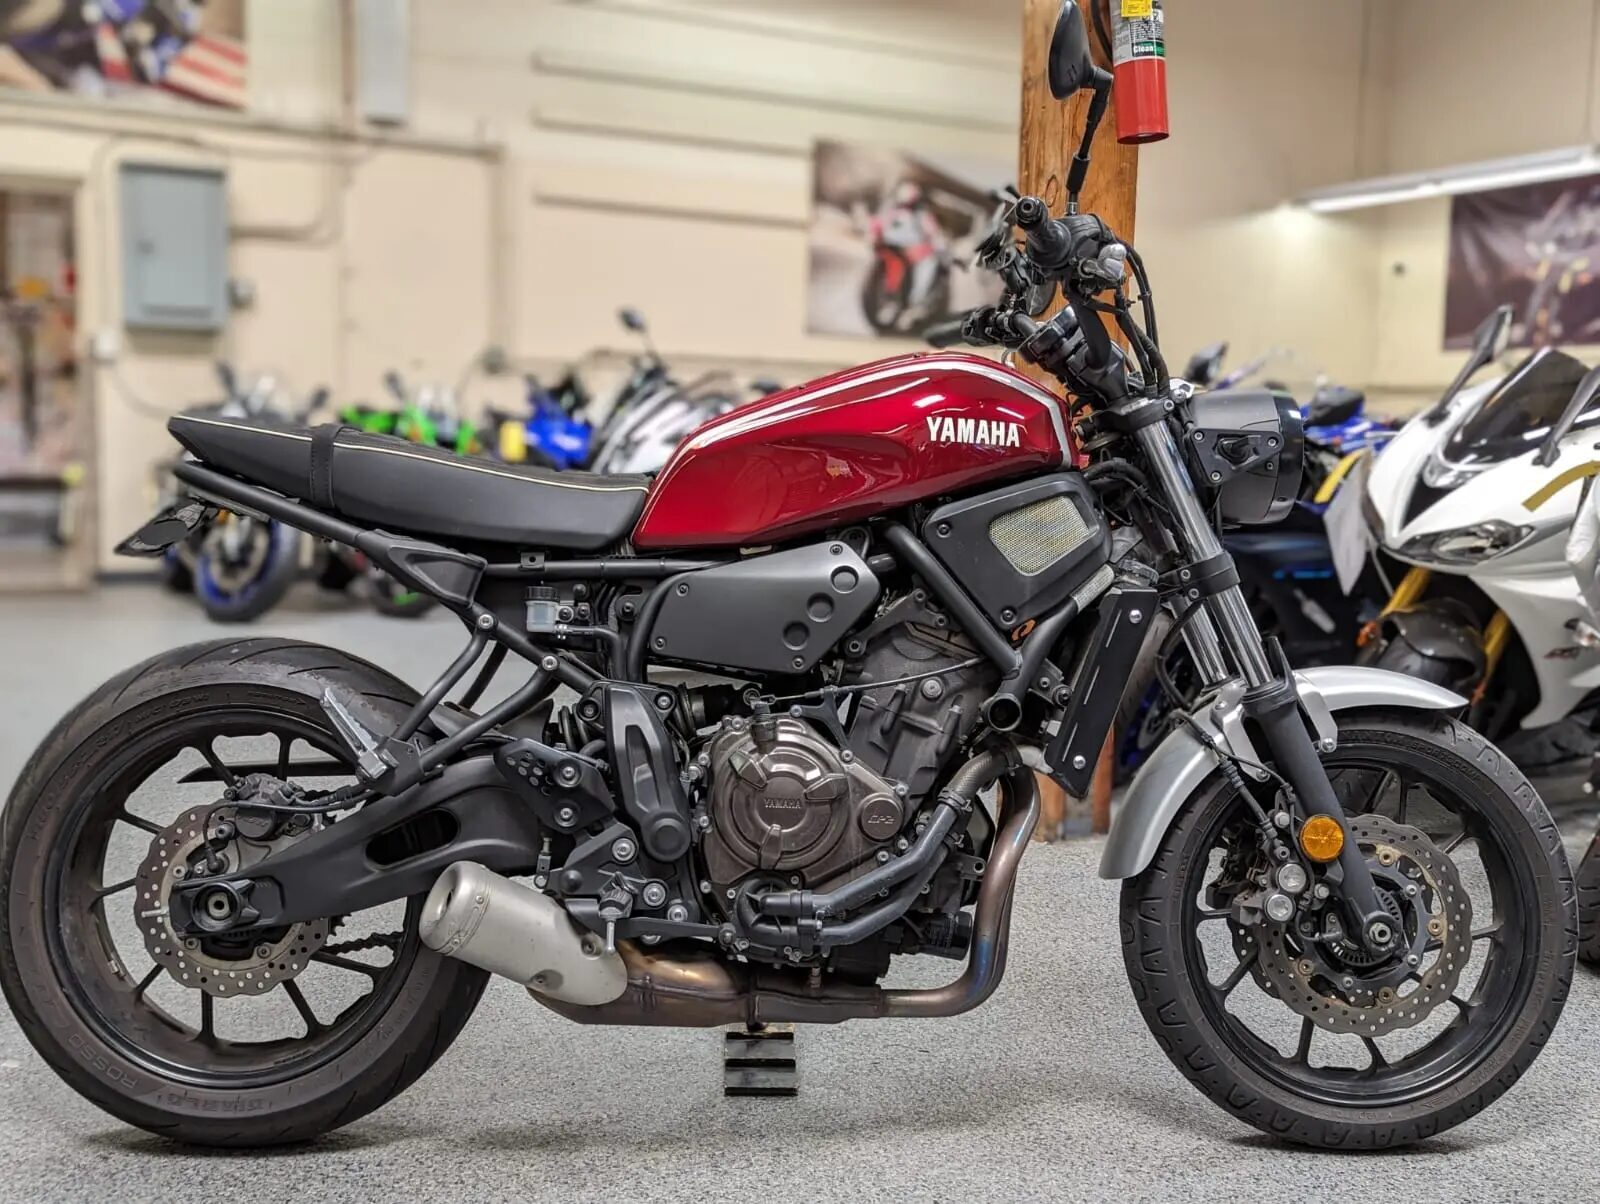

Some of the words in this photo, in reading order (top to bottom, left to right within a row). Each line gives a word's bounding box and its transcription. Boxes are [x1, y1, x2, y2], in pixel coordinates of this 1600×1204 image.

[926, 416, 1020, 448] YAMAHA
[763, 798, 801, 809] YAMAHA
[67, 1033, 138, 1089] ROSSO
